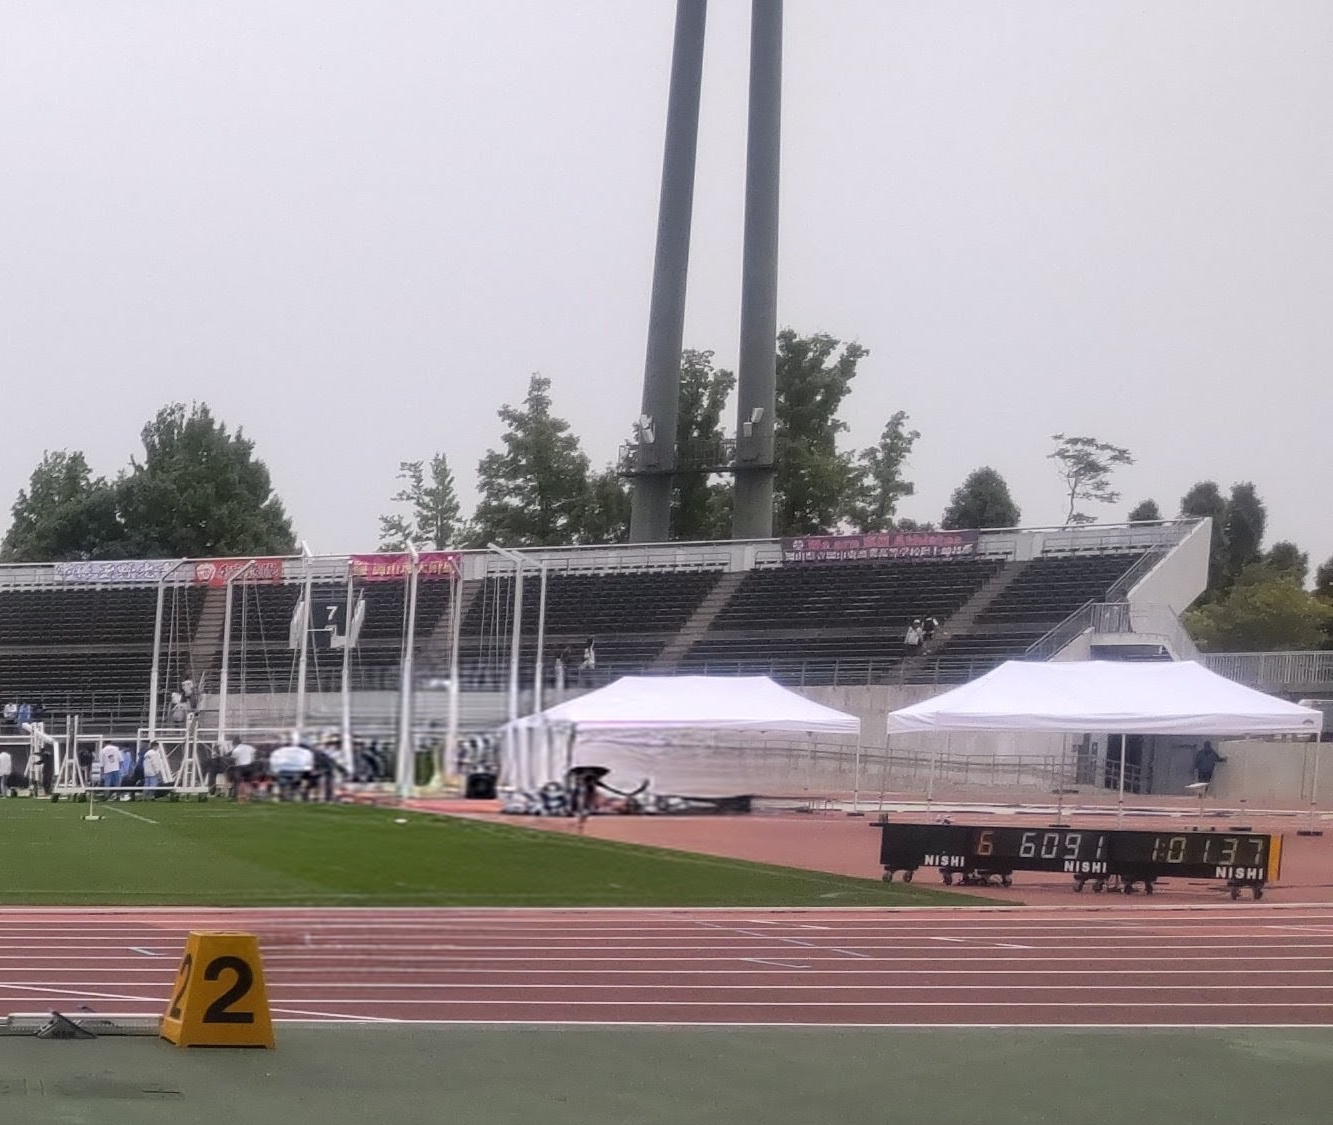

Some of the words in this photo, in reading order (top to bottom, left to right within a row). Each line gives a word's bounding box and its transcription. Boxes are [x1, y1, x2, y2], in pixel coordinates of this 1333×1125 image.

[326, 606, 338, 620] 7
[977, 830, 994, 856] 6
[1019, 832, 1104, 859] 6091
[924, 855, 965, 867] NISHI
[1064, 860, 1107, 873] NISHI
[1215, 866, 1263, 880] NISHI
[169, 953, 192, 1019] 2
[202, 955, 255, 1024] 2
